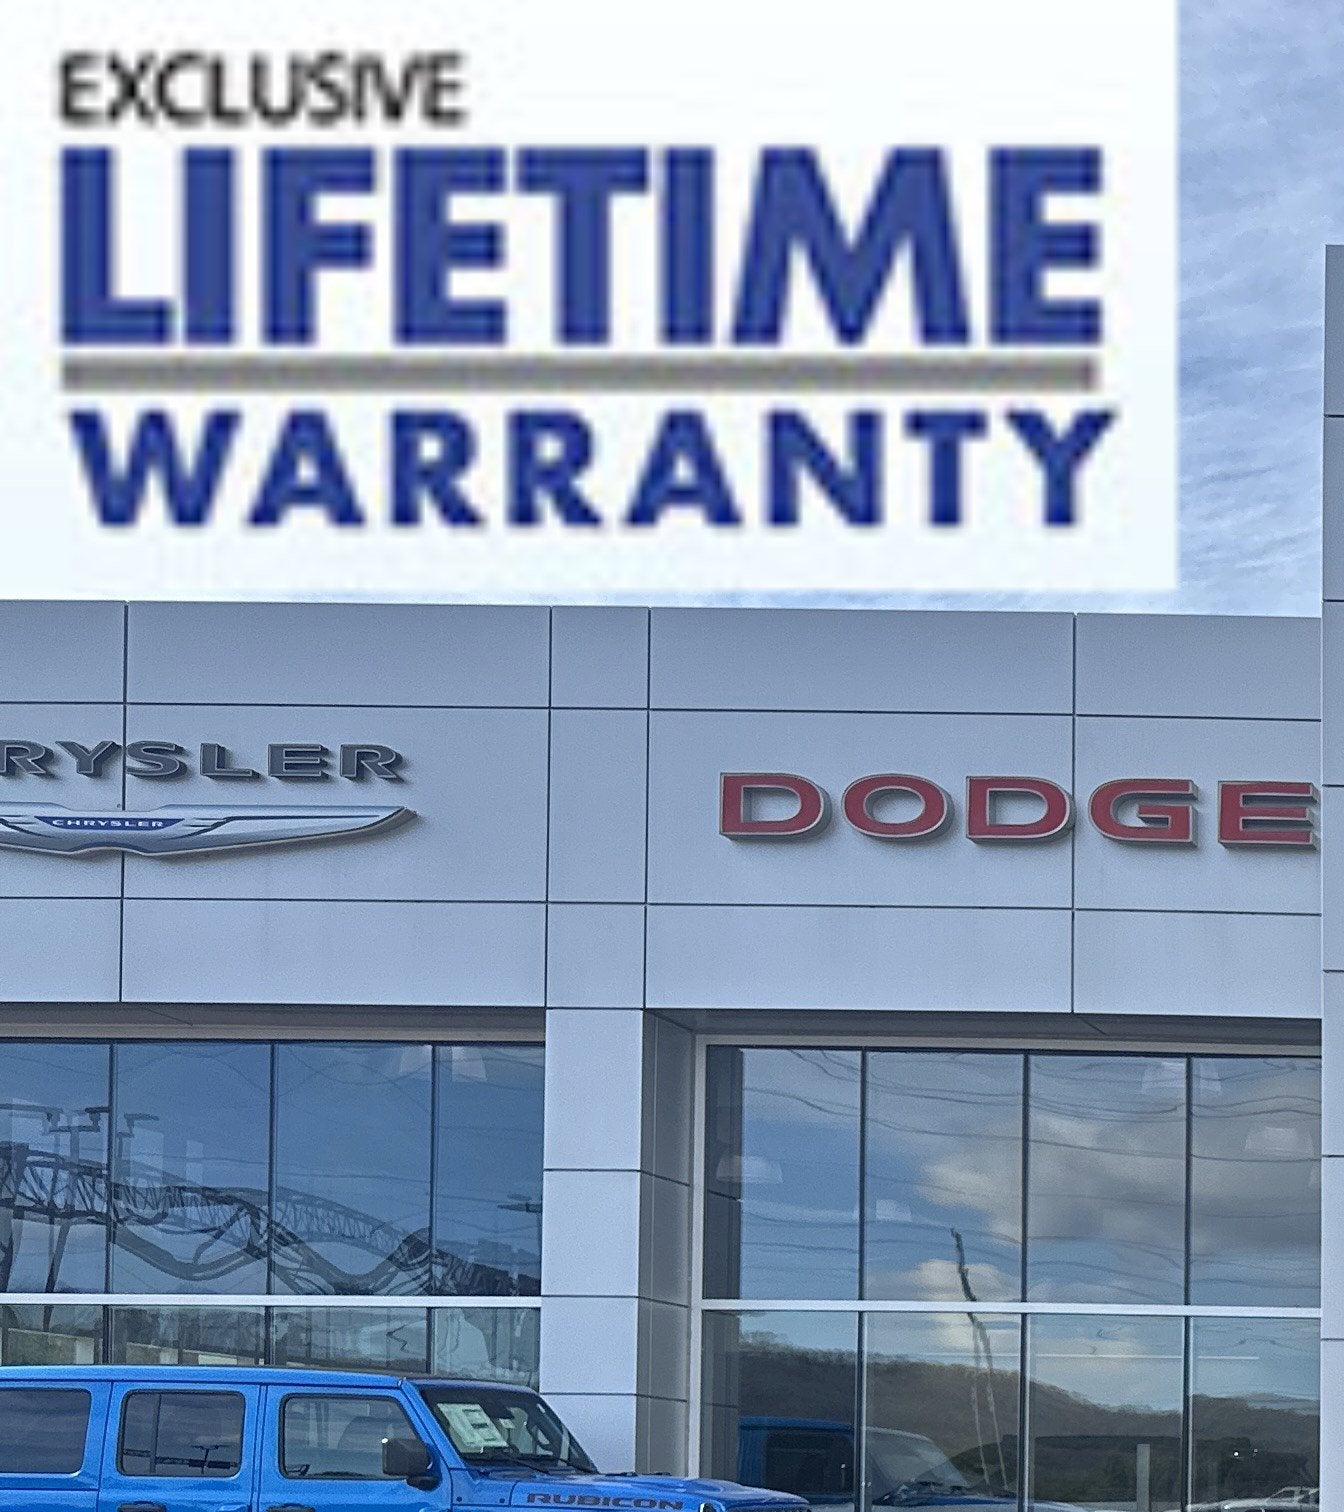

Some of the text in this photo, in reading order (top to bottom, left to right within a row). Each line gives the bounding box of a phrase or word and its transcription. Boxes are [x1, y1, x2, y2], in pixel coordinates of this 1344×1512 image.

[719, 772, 1318, 850] DODGE
[52, 819, 164, 827] CHRYSLER
[526, 1492, 684, 1510] RUBICON
